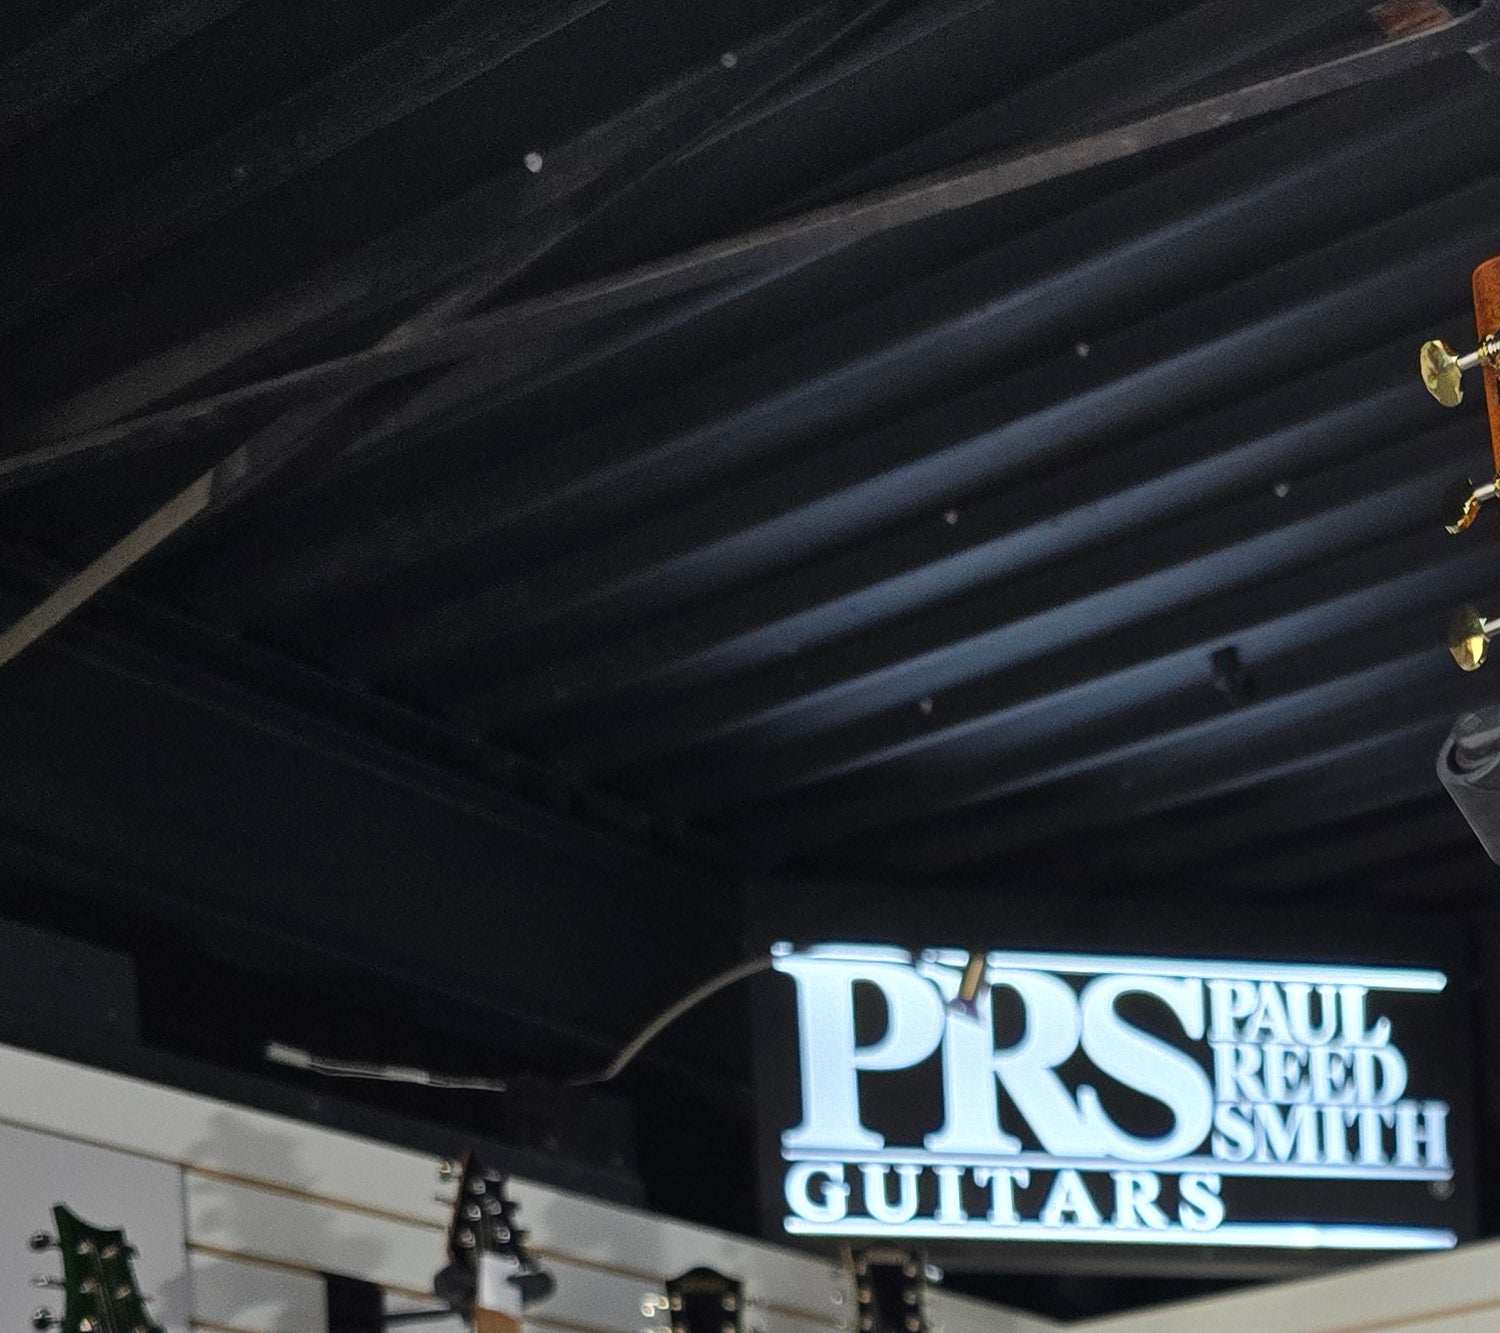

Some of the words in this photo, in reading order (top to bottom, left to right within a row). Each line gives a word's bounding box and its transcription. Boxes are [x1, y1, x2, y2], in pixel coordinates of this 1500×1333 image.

[1209, 979, 1391, 1045] PAUL
[774, 957, 1213, 1163] PRS
[1211, 1042, 1408, 1105] REED
[1211, 1103, 1450, 1166] SMITH
[784, 1161, 1227, 1231] GUITARS
